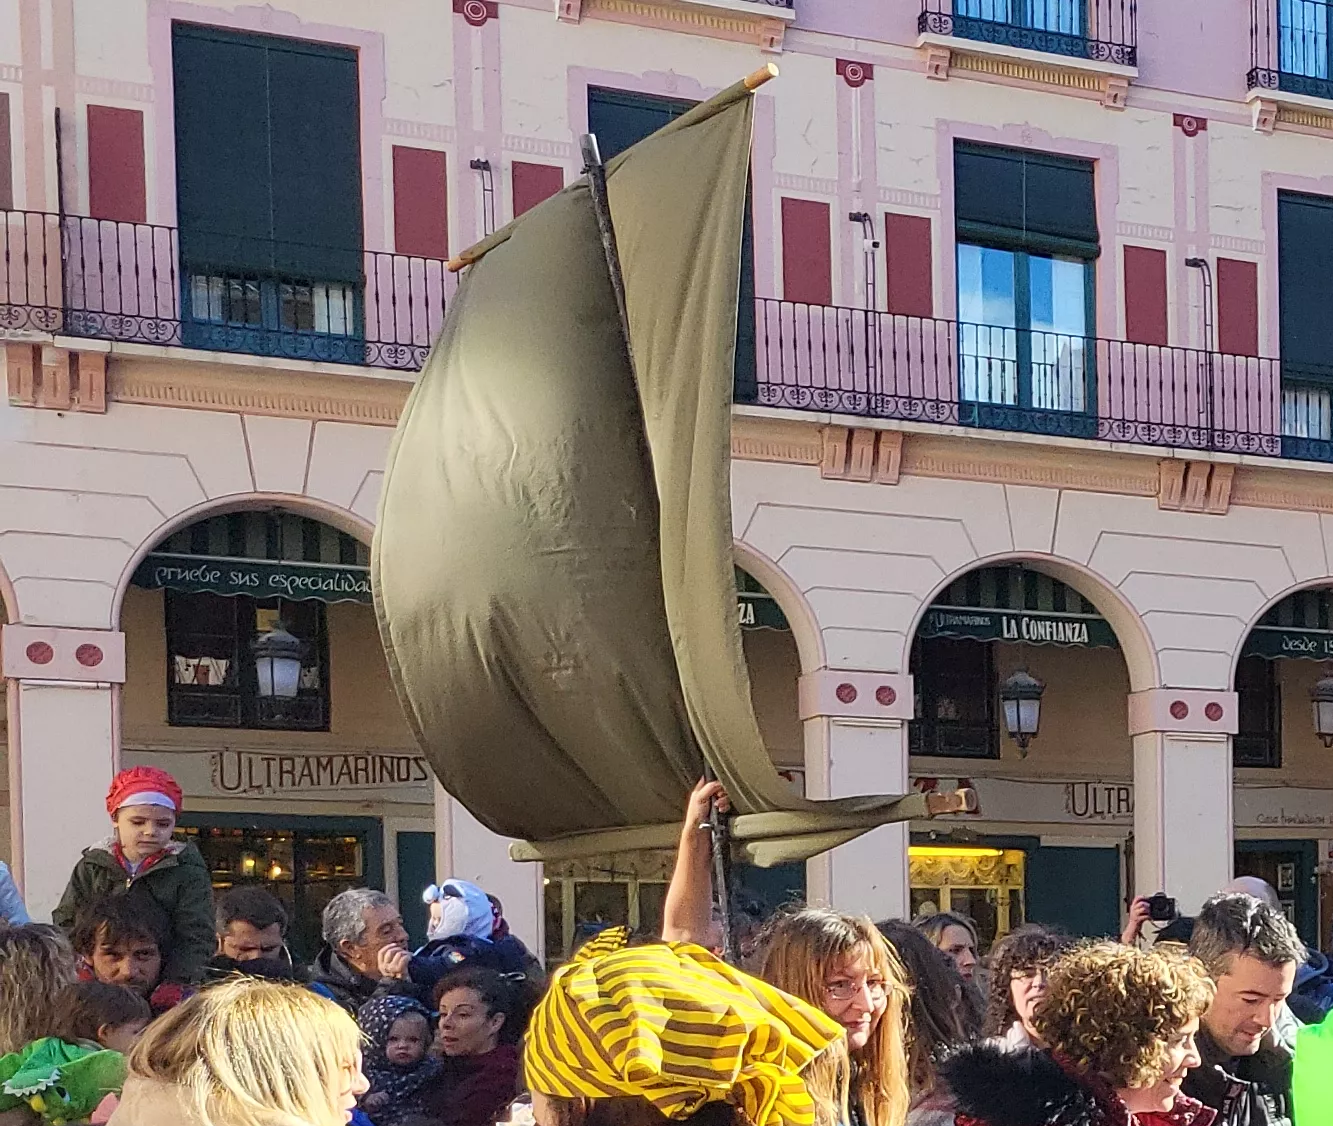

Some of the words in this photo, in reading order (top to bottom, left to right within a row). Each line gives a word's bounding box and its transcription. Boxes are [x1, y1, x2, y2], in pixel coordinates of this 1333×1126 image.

[155, 565, 221, 585] pruebe
[229, 572, 260, 586] sus
[1002, 616, 1019, 639] LA
[1021, 617, 1089, 643] CONFIANZA
[1282, 635, 1317, 652] desde
[219, 750, 429, 791] ULTRAMARINOS
[1072, 783, 1134, 816] ULTR
